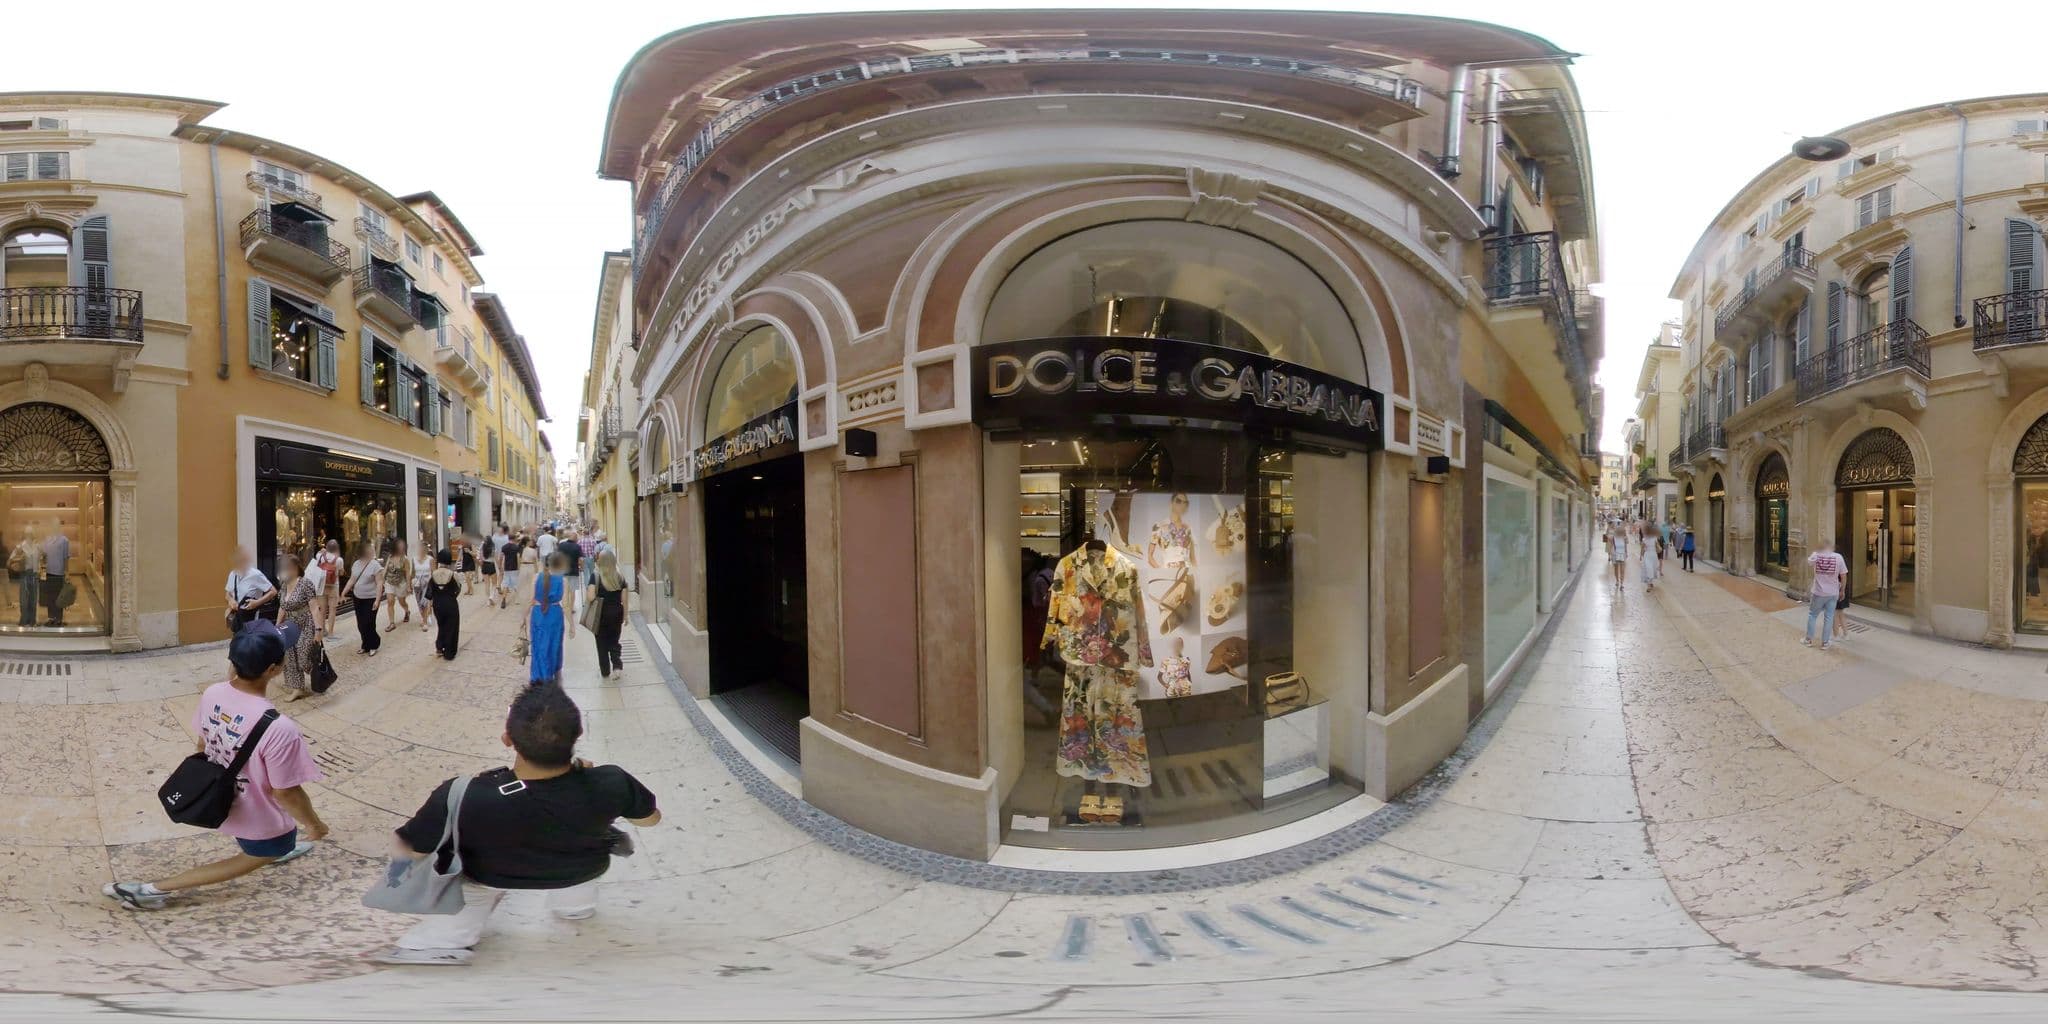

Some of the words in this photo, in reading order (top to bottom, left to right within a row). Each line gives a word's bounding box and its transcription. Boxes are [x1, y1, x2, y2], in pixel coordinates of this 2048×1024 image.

[672, 279, 708, 342] DOLCE
[716, 159, 897, 283] GABBANA
[988, 348, 1159, 399] DOLCE
[1167, 371, 1189, 395] &
[1191, 357, 1381, 432] GABBANA
[1763, 481, 1789, 491] GUCCI
[1850, 465, 1901, 480] GUCCI
